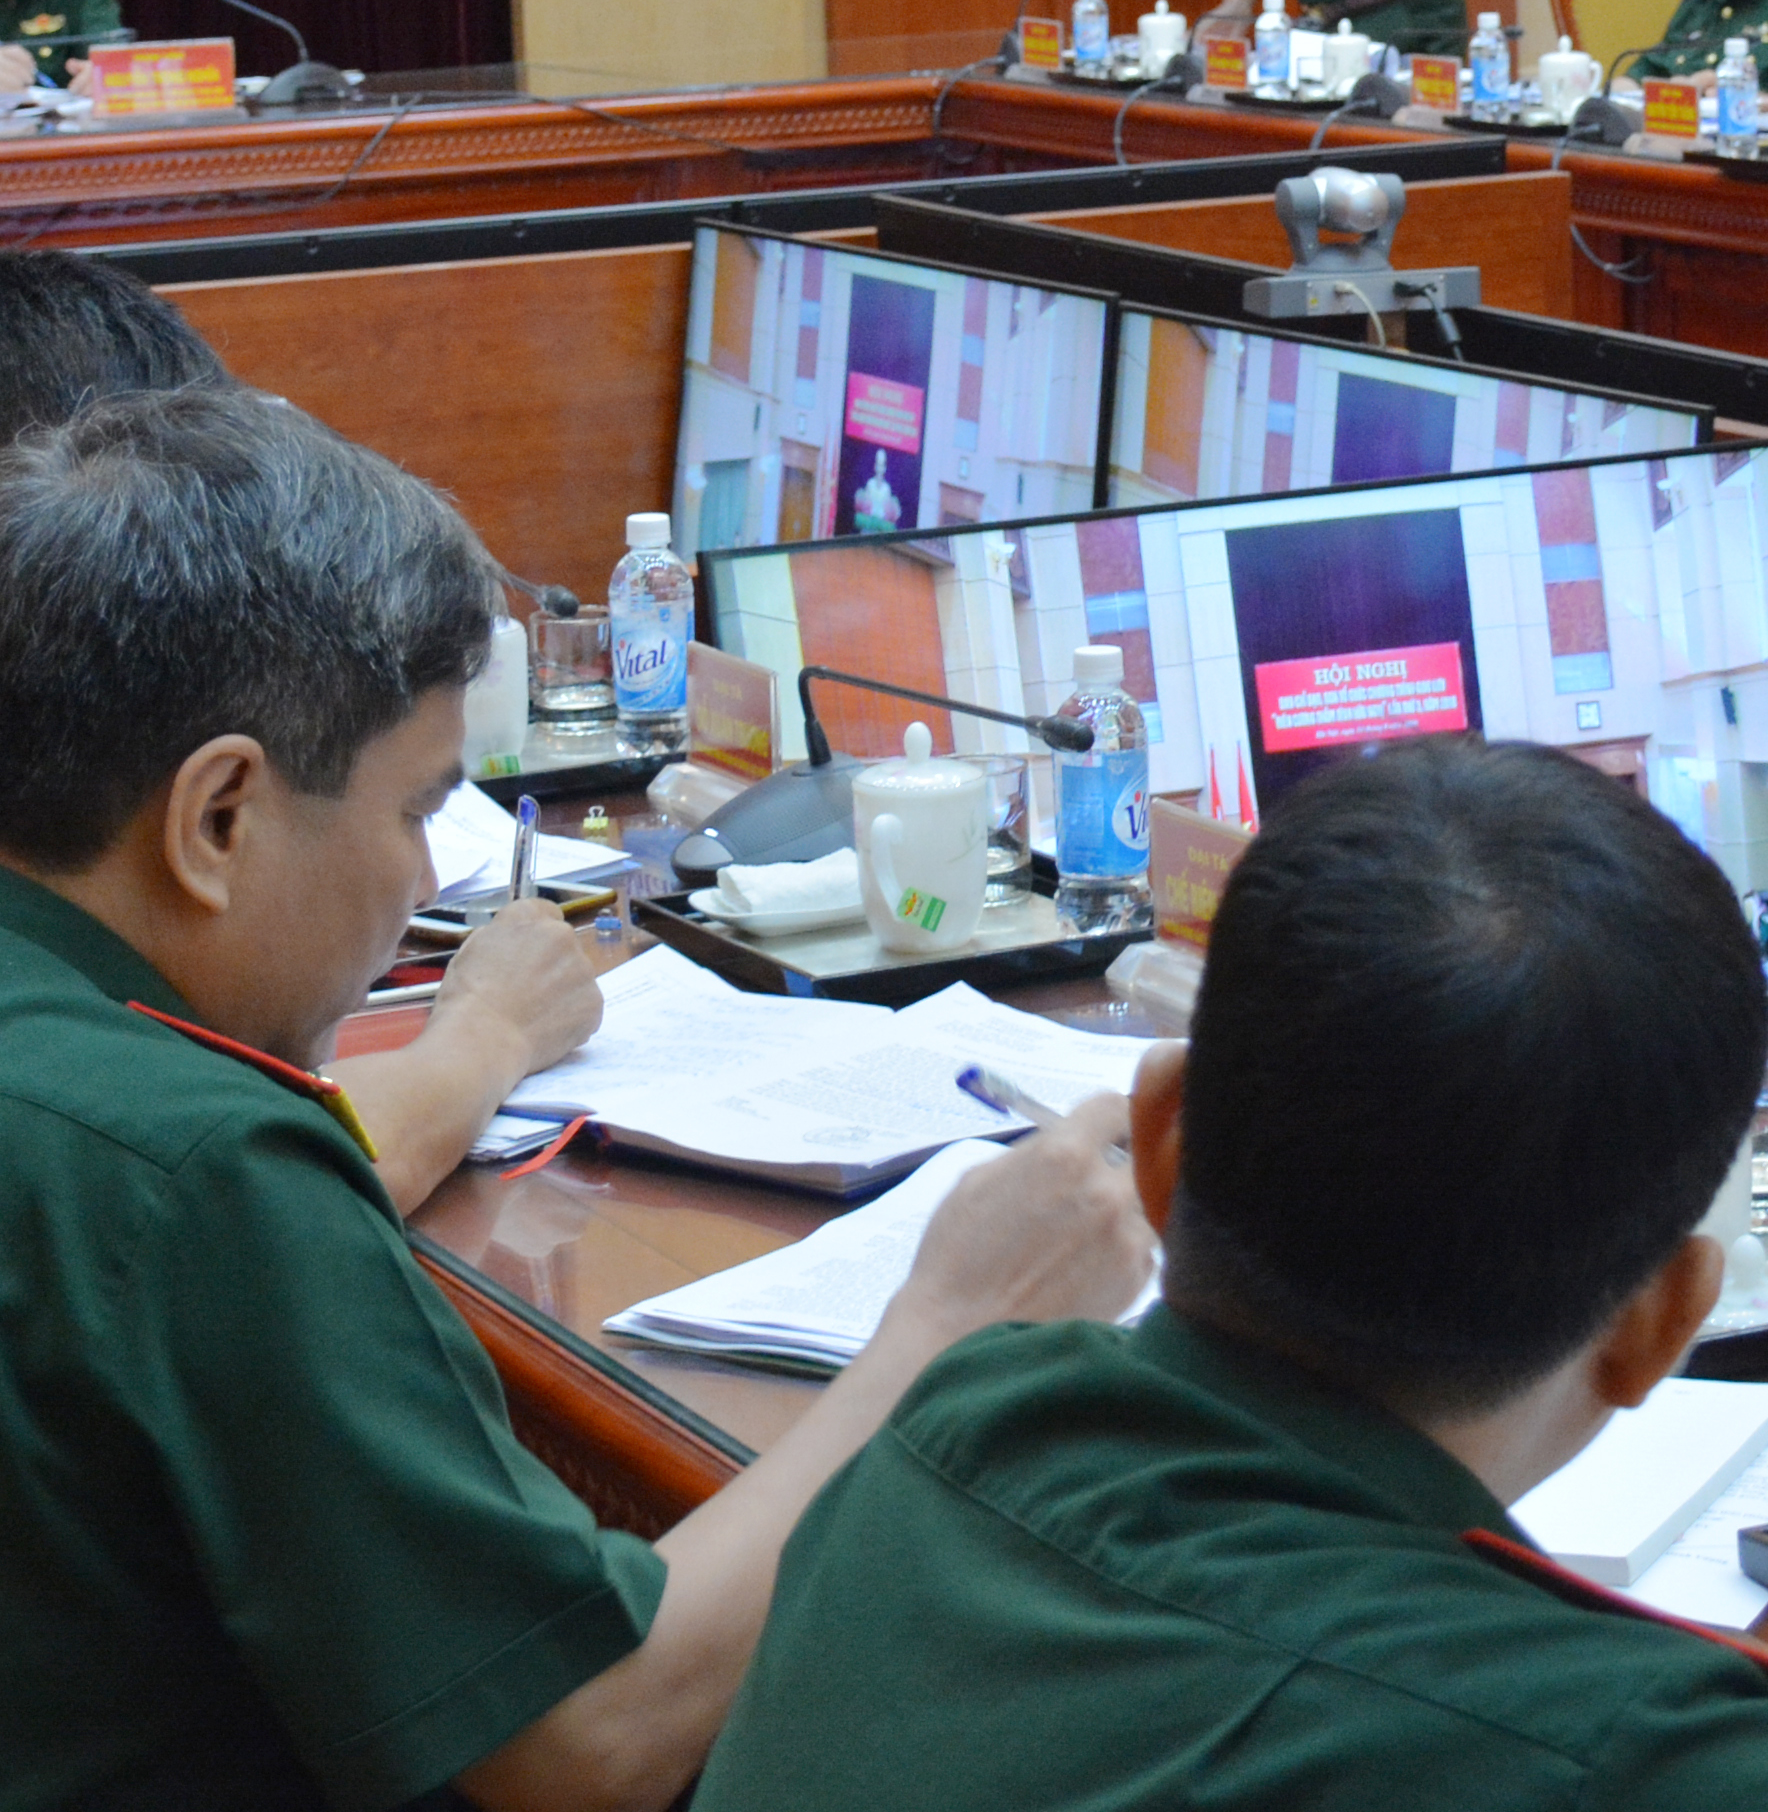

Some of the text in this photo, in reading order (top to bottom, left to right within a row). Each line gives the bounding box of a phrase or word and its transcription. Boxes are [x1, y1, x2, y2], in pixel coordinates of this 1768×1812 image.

[615, 639, 667, 680] Vital
[1314, 659, 1408, 686] HỘI NGHỊ
